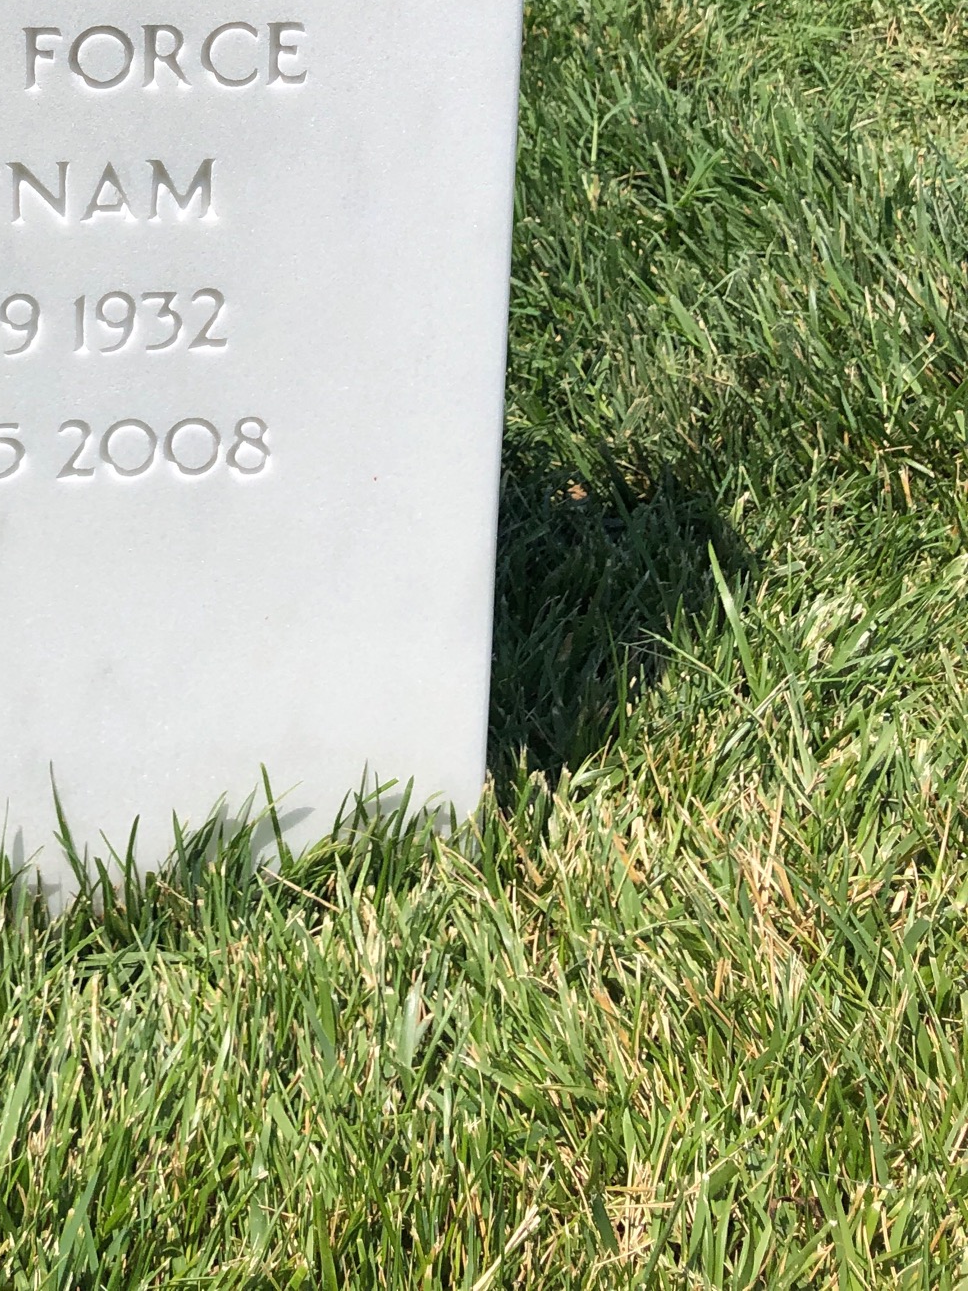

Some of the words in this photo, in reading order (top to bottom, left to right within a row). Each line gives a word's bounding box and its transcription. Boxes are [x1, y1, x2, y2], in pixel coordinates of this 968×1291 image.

[22, 20, 308, 92] FORCE
[73, 286, 229, 353] 1932
[56, 415, 272, 480] 2008
